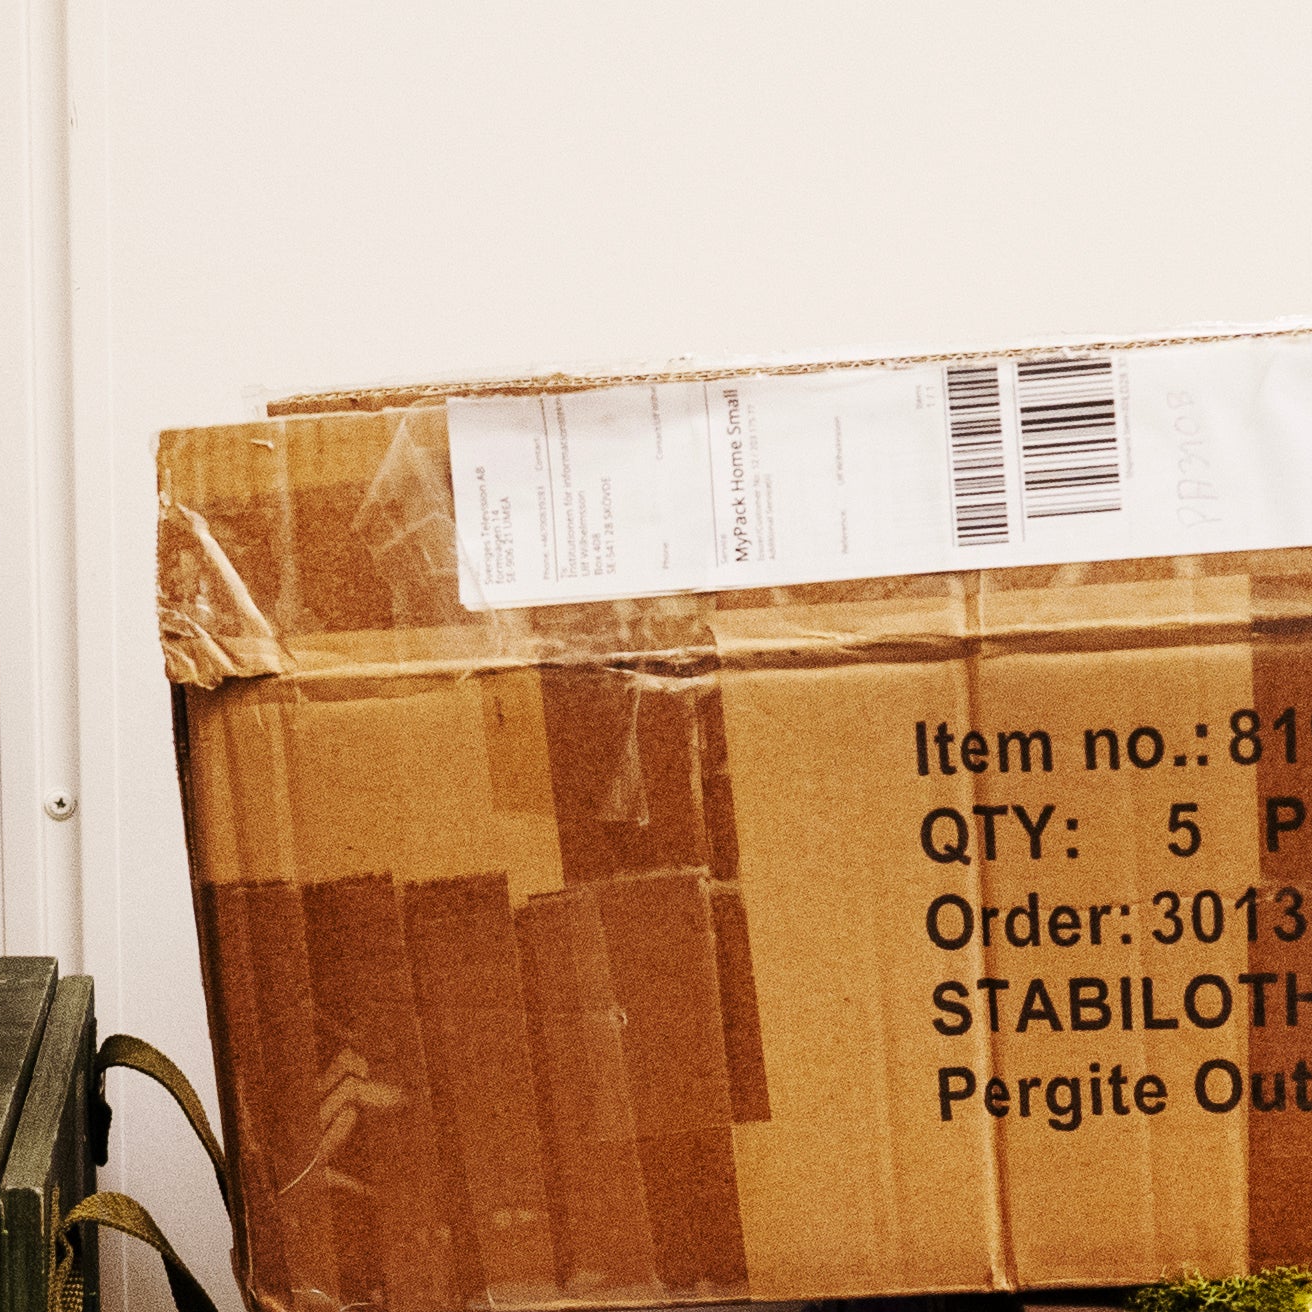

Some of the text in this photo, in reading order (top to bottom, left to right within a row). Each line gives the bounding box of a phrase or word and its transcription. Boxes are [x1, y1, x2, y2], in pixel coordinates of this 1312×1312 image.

[722, 388, 752, 562] MyPack Home Small
[915, 720, 1054, 776] Item
[1084, 724, 1210, 771] no.:
[919, 803, 1081, 865] QTY:
[1167, 802, 1202, 858] 5
[925, 892, 1134, 951] Order:
[938, 1063, 1169, 1132] Pergite
